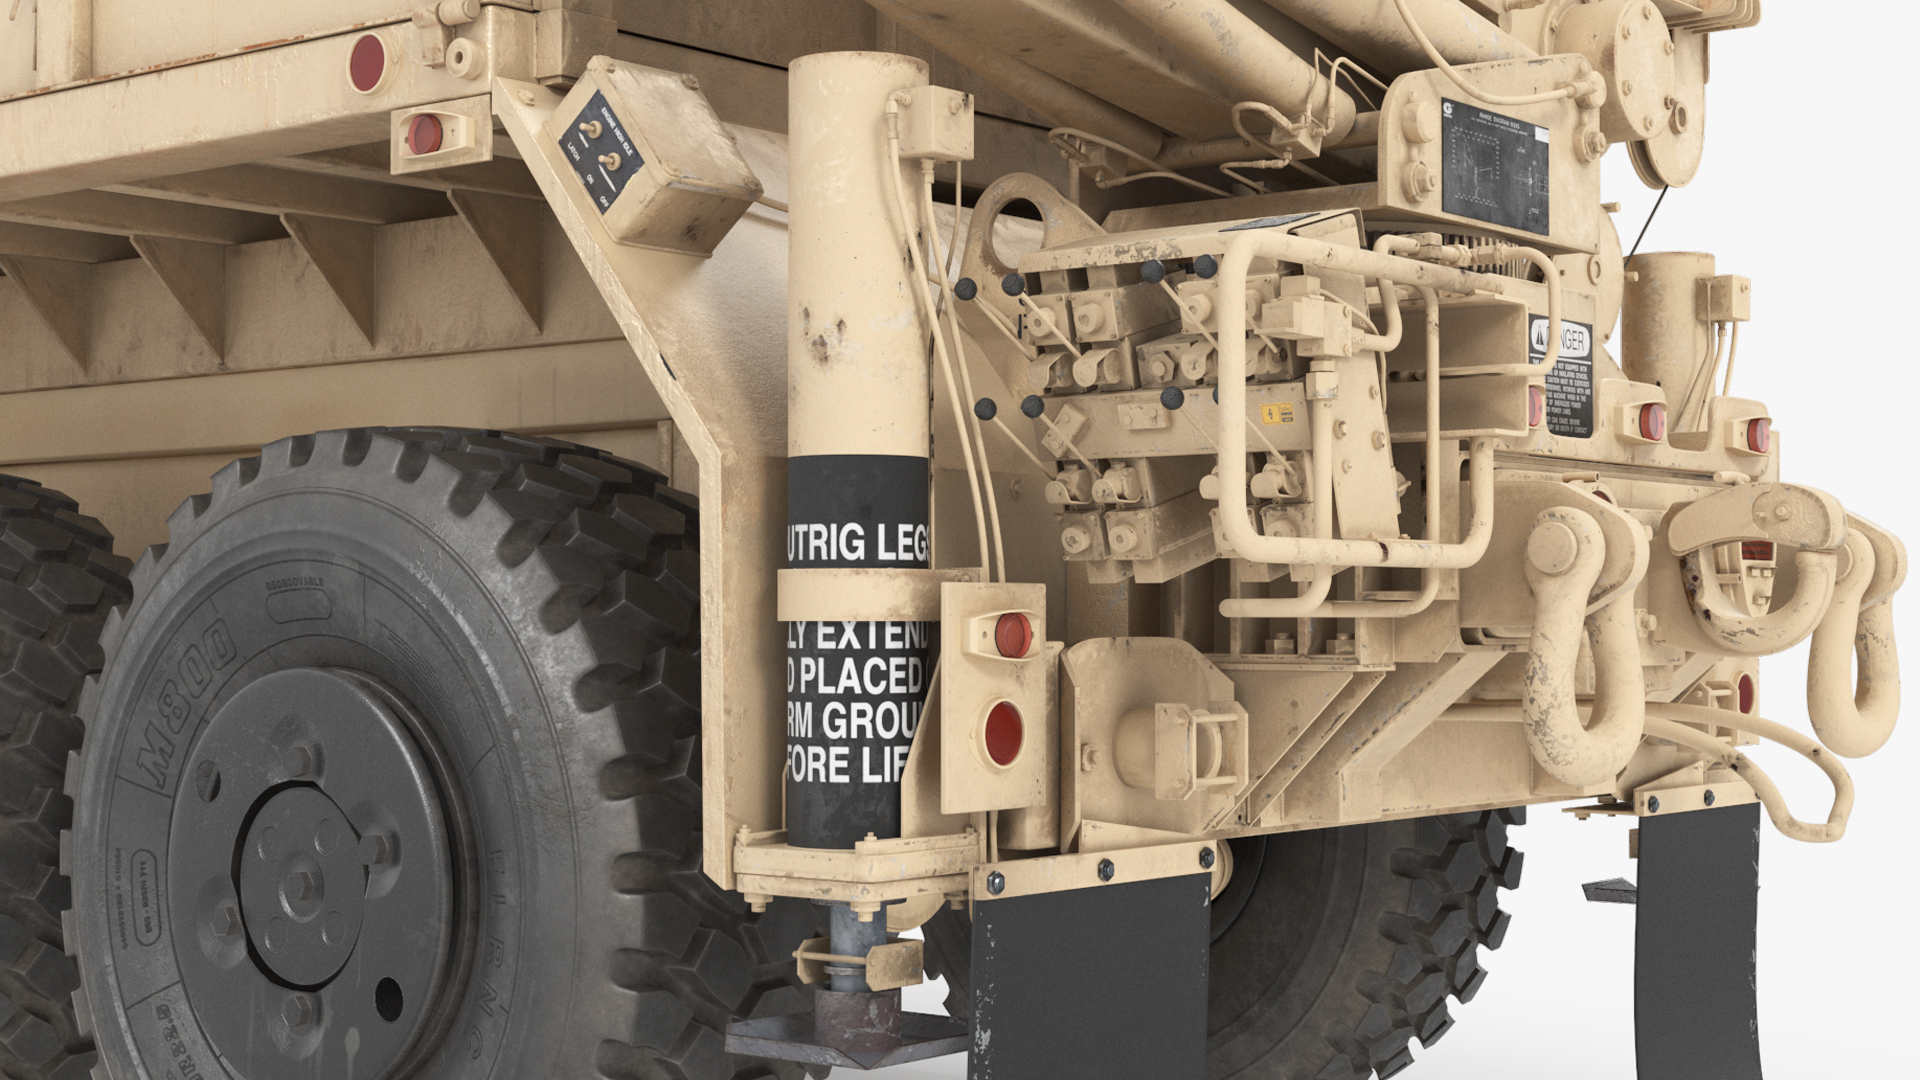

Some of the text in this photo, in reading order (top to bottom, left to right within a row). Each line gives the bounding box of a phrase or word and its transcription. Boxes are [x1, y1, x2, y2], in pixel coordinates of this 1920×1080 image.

[622, 141, 633, 157] IDLE
[877, 522, 929, 562] LEG
[800, 656, 922, 695] PLACED
[136, 617, 237, 790] M800
[822, 700, 923, 740] GROU
